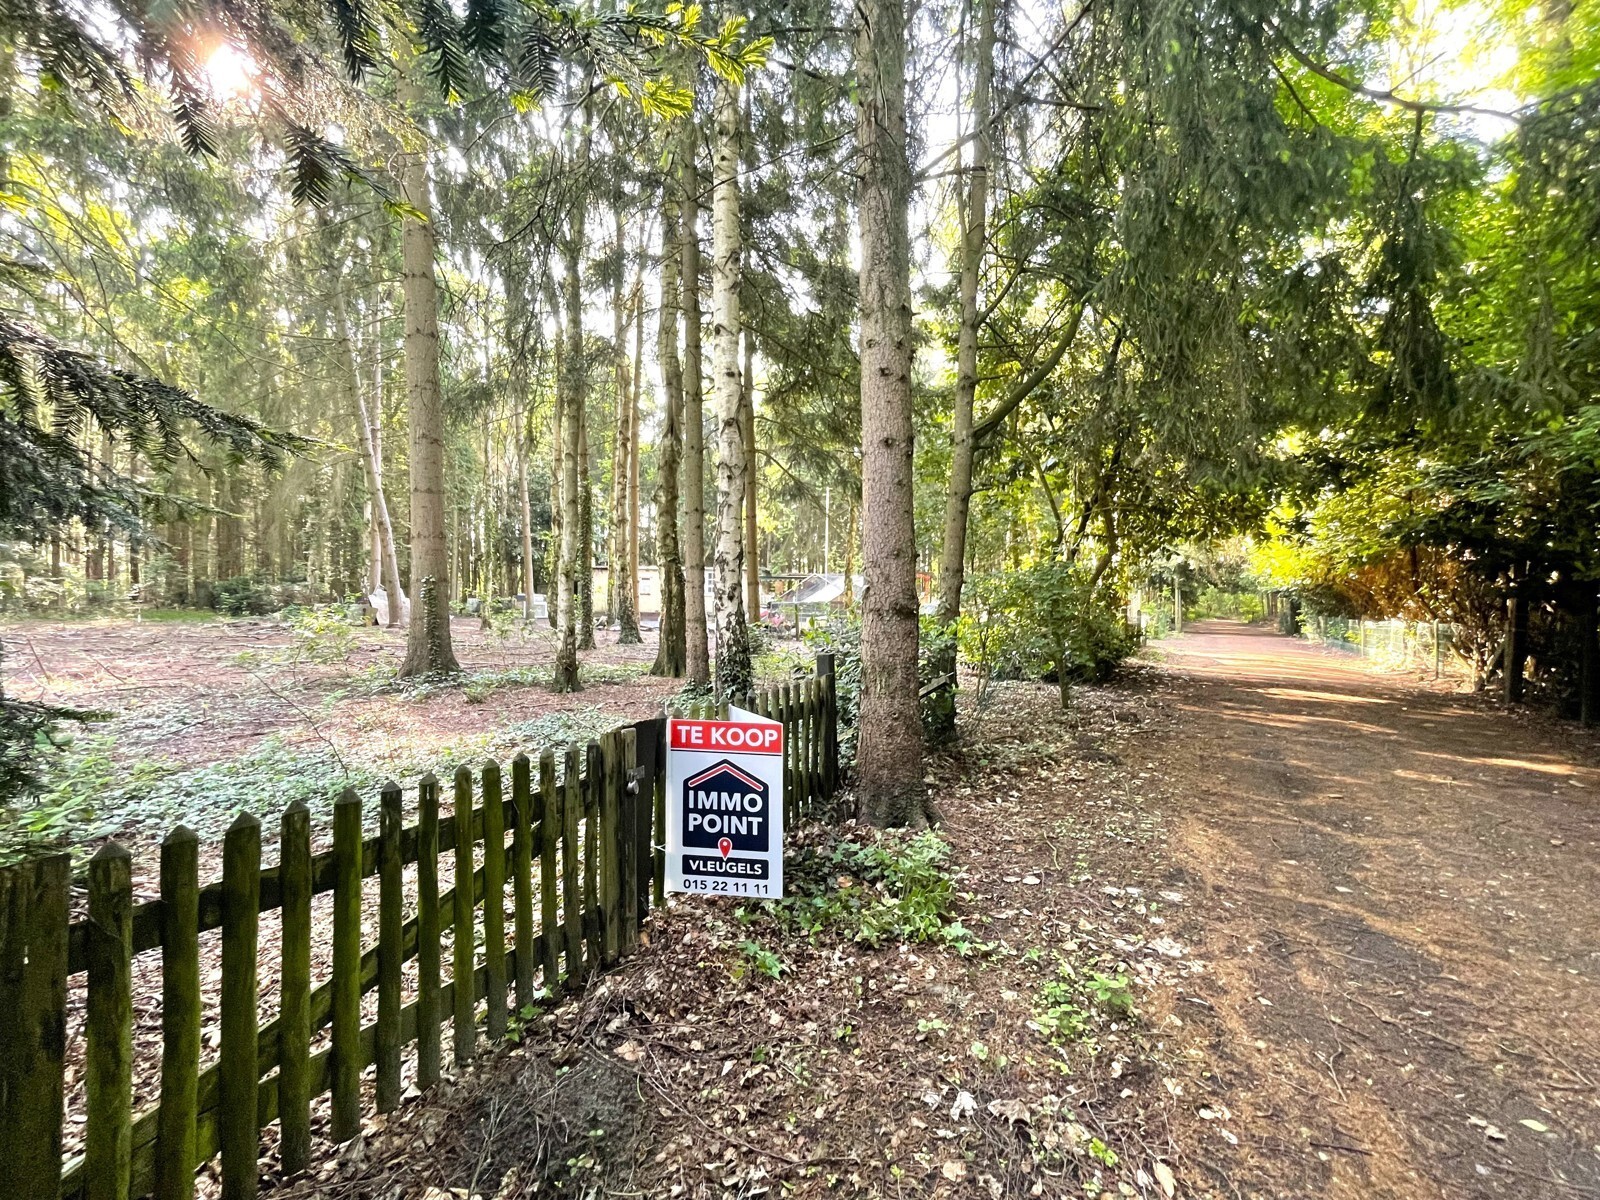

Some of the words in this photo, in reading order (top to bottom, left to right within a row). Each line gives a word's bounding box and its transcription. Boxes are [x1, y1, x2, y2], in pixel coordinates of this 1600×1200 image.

[677, 726, 703, 744] TE
[711, 727, 778, 747] KOOP
[689, 790, 763, 812] IMMO
[688, 813, 762, 835] POINT
[689, 860, 762, 875] VLEUGELS
[683, 879, 707, 889] 015
[712, 881, 728, 891] 22
[734, 883, 747, 893] 11
[754, 884, 768, 894] 11
